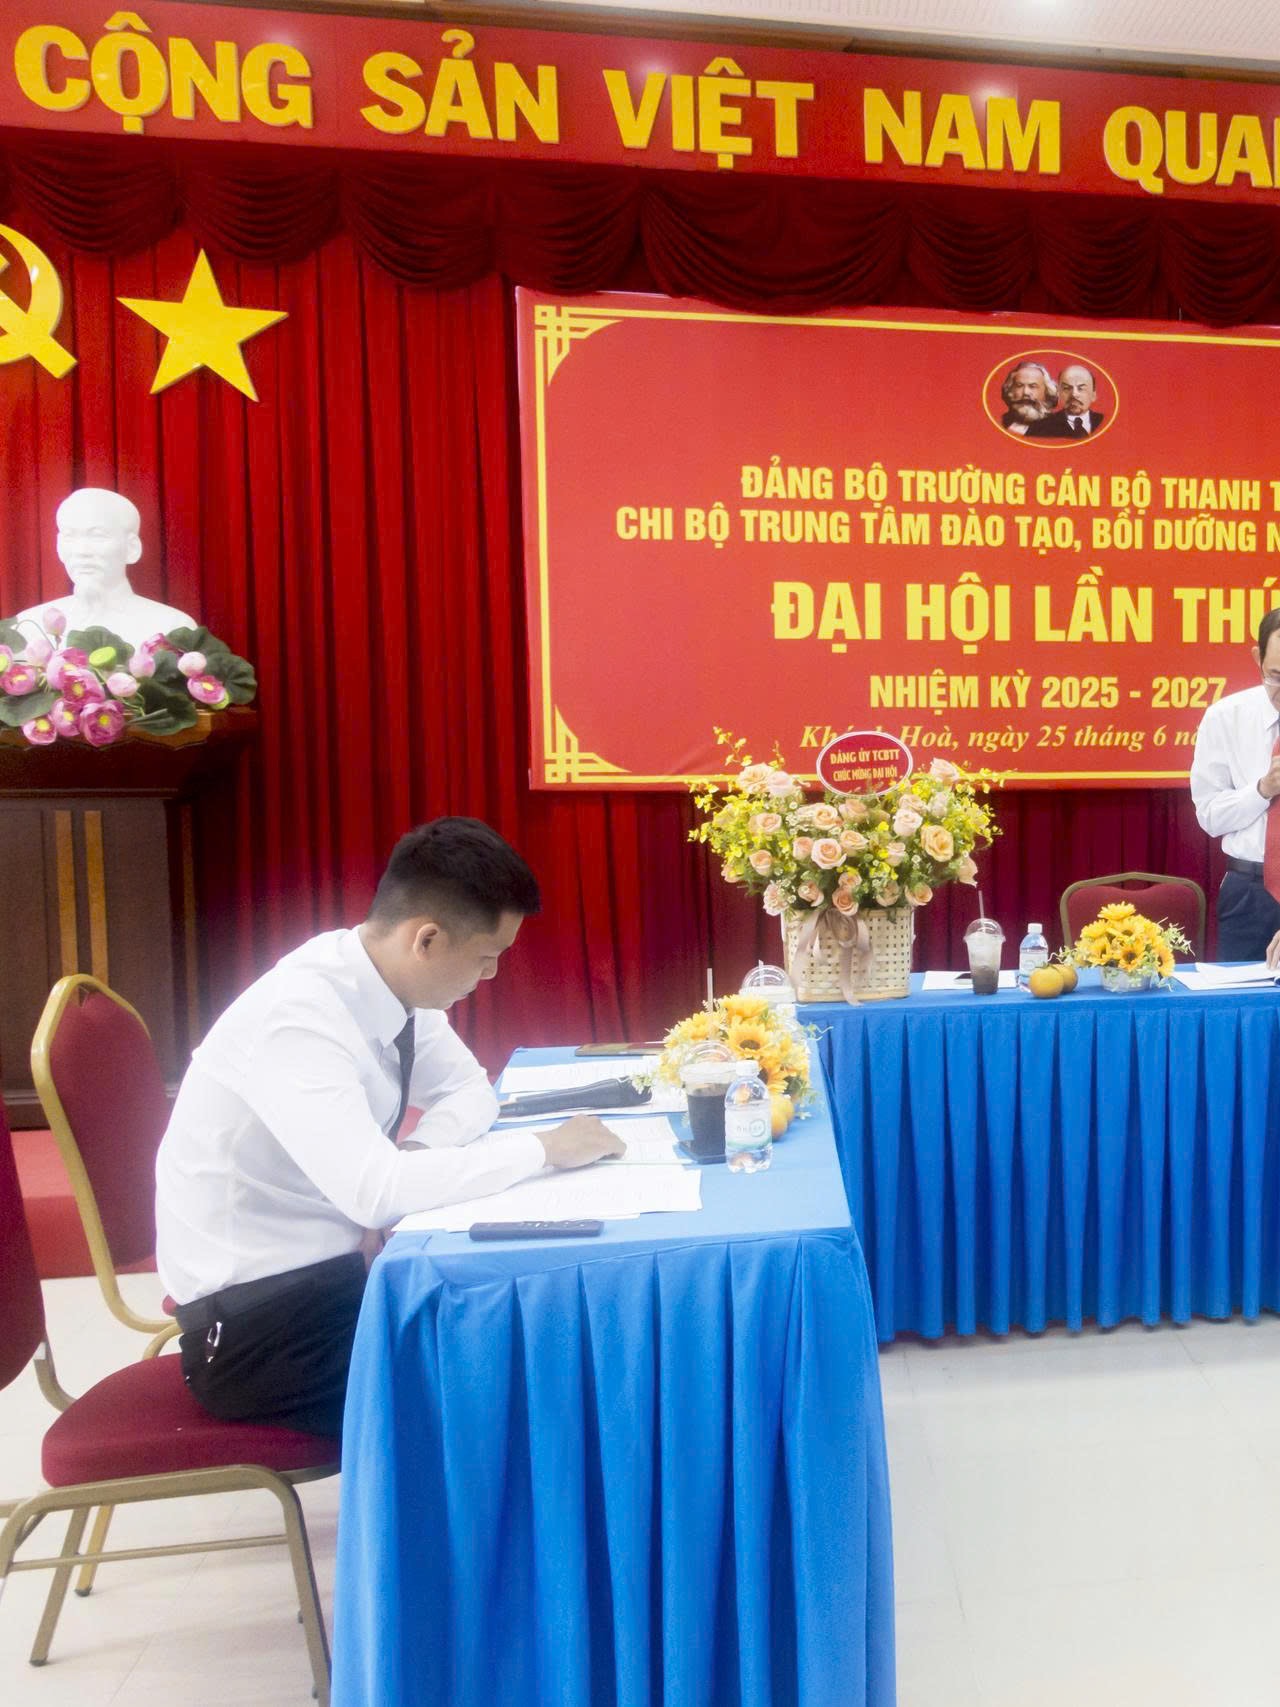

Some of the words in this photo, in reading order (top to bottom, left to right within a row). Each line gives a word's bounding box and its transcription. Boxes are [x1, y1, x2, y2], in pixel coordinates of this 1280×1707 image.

[14, 11, 313, 133] CỘNG
[360, 30, 560, 144] SẢN
[603, 56, 815, 169] VIỆT
[862, 88, 1061, 174] NAM
[741, 455, 833, 500] ĐẢNG
[844, 462, 888, 508] BỘ
[898, 464, 1025, 505] TRƯỜNG
[1036, 468, 1100, 507] CÁN
[1111, 470, 1151, 514] BỘ
[1161, 477, 1260, 511] THANH
[616, 506, 673, 540] CHI
[685, 502, 730, 549] BỘ
[740, 509, 850, 544] TRUNG
[860, 506, 930, 545] TÂM
[940, 508, 1005, 547] ĐÀO
[1015, 516, 1082, 555] TẠO,
[1092, 508, 1143, 550] BỒI
[1153, 513, 1256, 553] DƯỠNG
[771, 581, 882, 653] ĐẠI
[906, 572, 1011, 654] HỘI
[1034, 566, 1153, 643] LẦN
[870, 668, 979, 715] NHIỆM
[990, 669, 1031, 708] KỲ
[1041, 676, 1119, 708] 2025
[1129, 690, 1141, 698] -
[1151, 677, 1227, 708] 2027
[872, 749, 900, 761] TCBTT
[899, 725, 959, 750] Hoà,
[968, 725, 1029, 752] ngày
[1037, 725, 1067, 747] 25
[1074, 725, 1145, 752] tháng
[1153, 725, 1167, 746] 6
